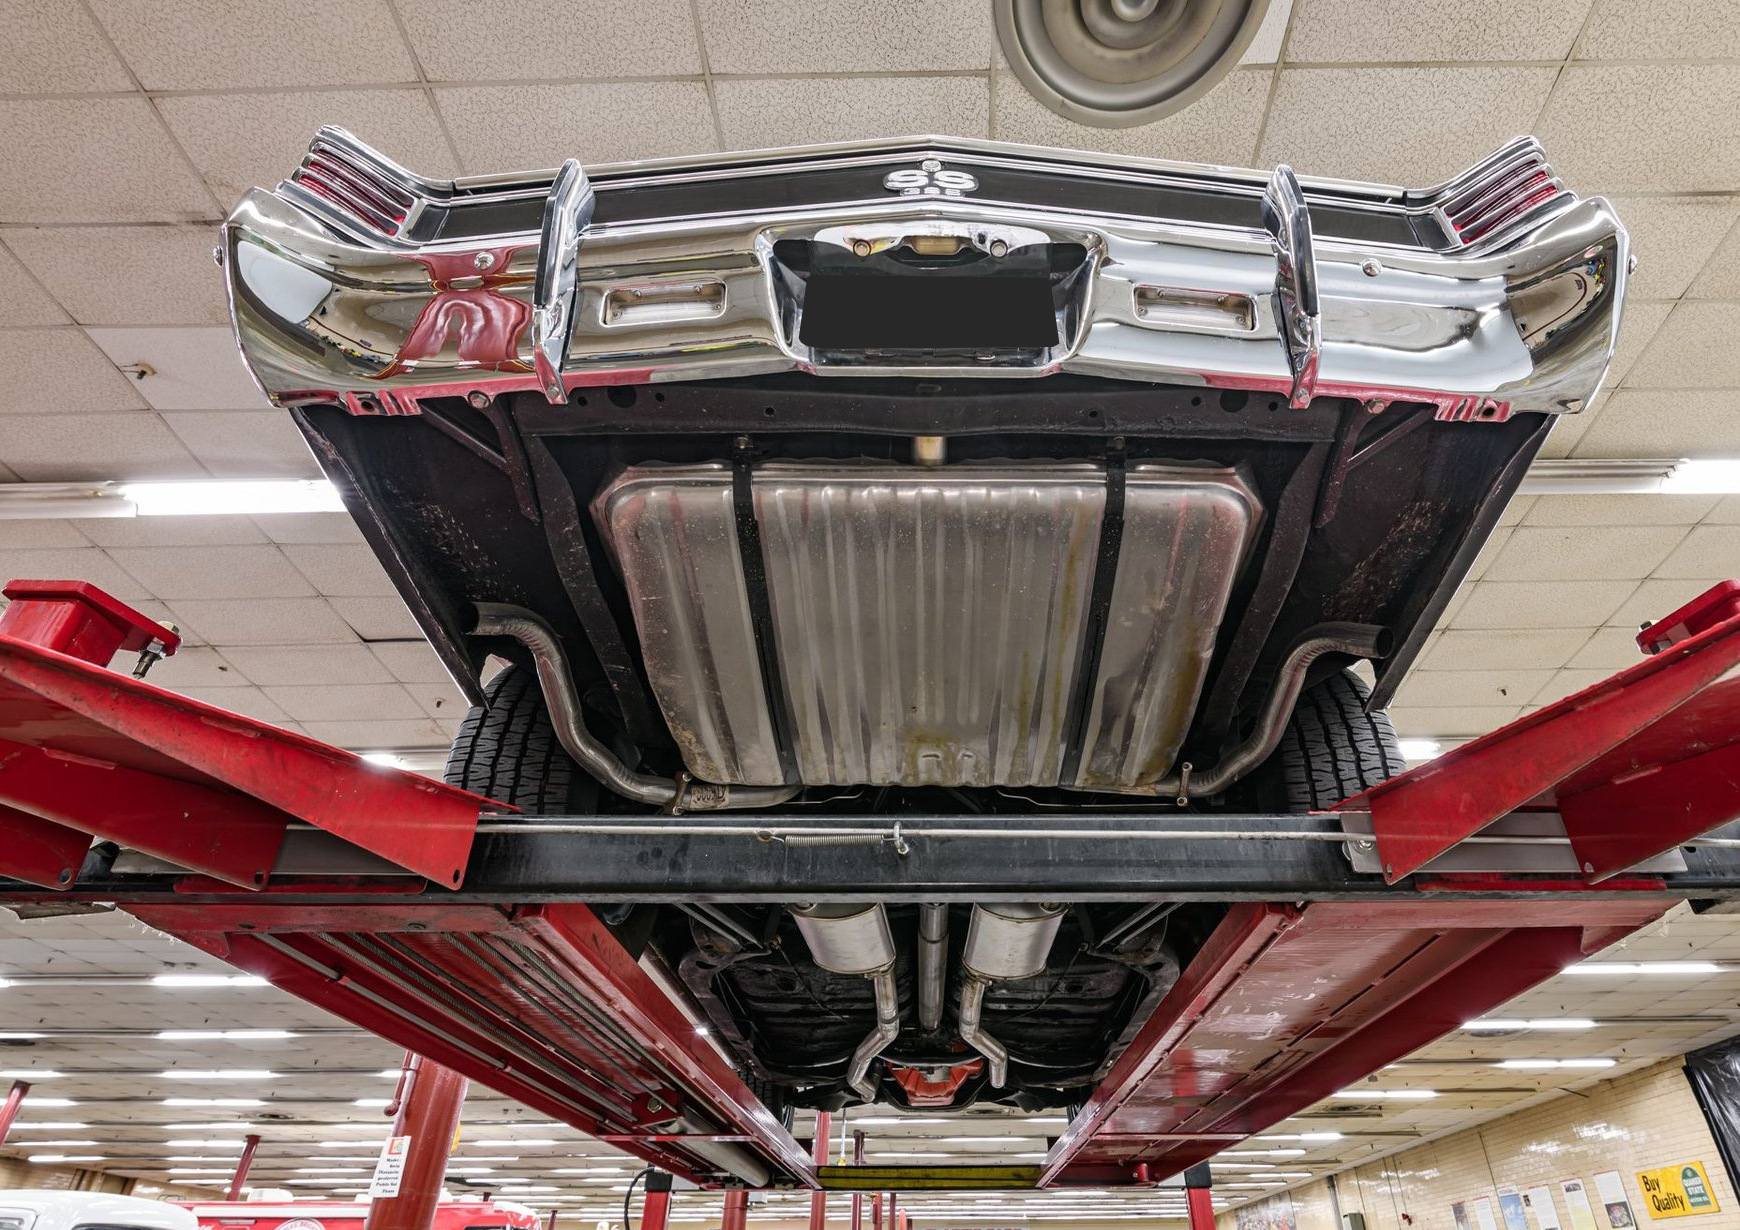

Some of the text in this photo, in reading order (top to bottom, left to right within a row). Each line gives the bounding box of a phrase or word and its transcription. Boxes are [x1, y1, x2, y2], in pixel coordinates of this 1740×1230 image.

[885, 169, 976, 189] SS
[1641, 1175, 1662, 1194] Buy
[1651, 1192, 1686, 1213] Quality
